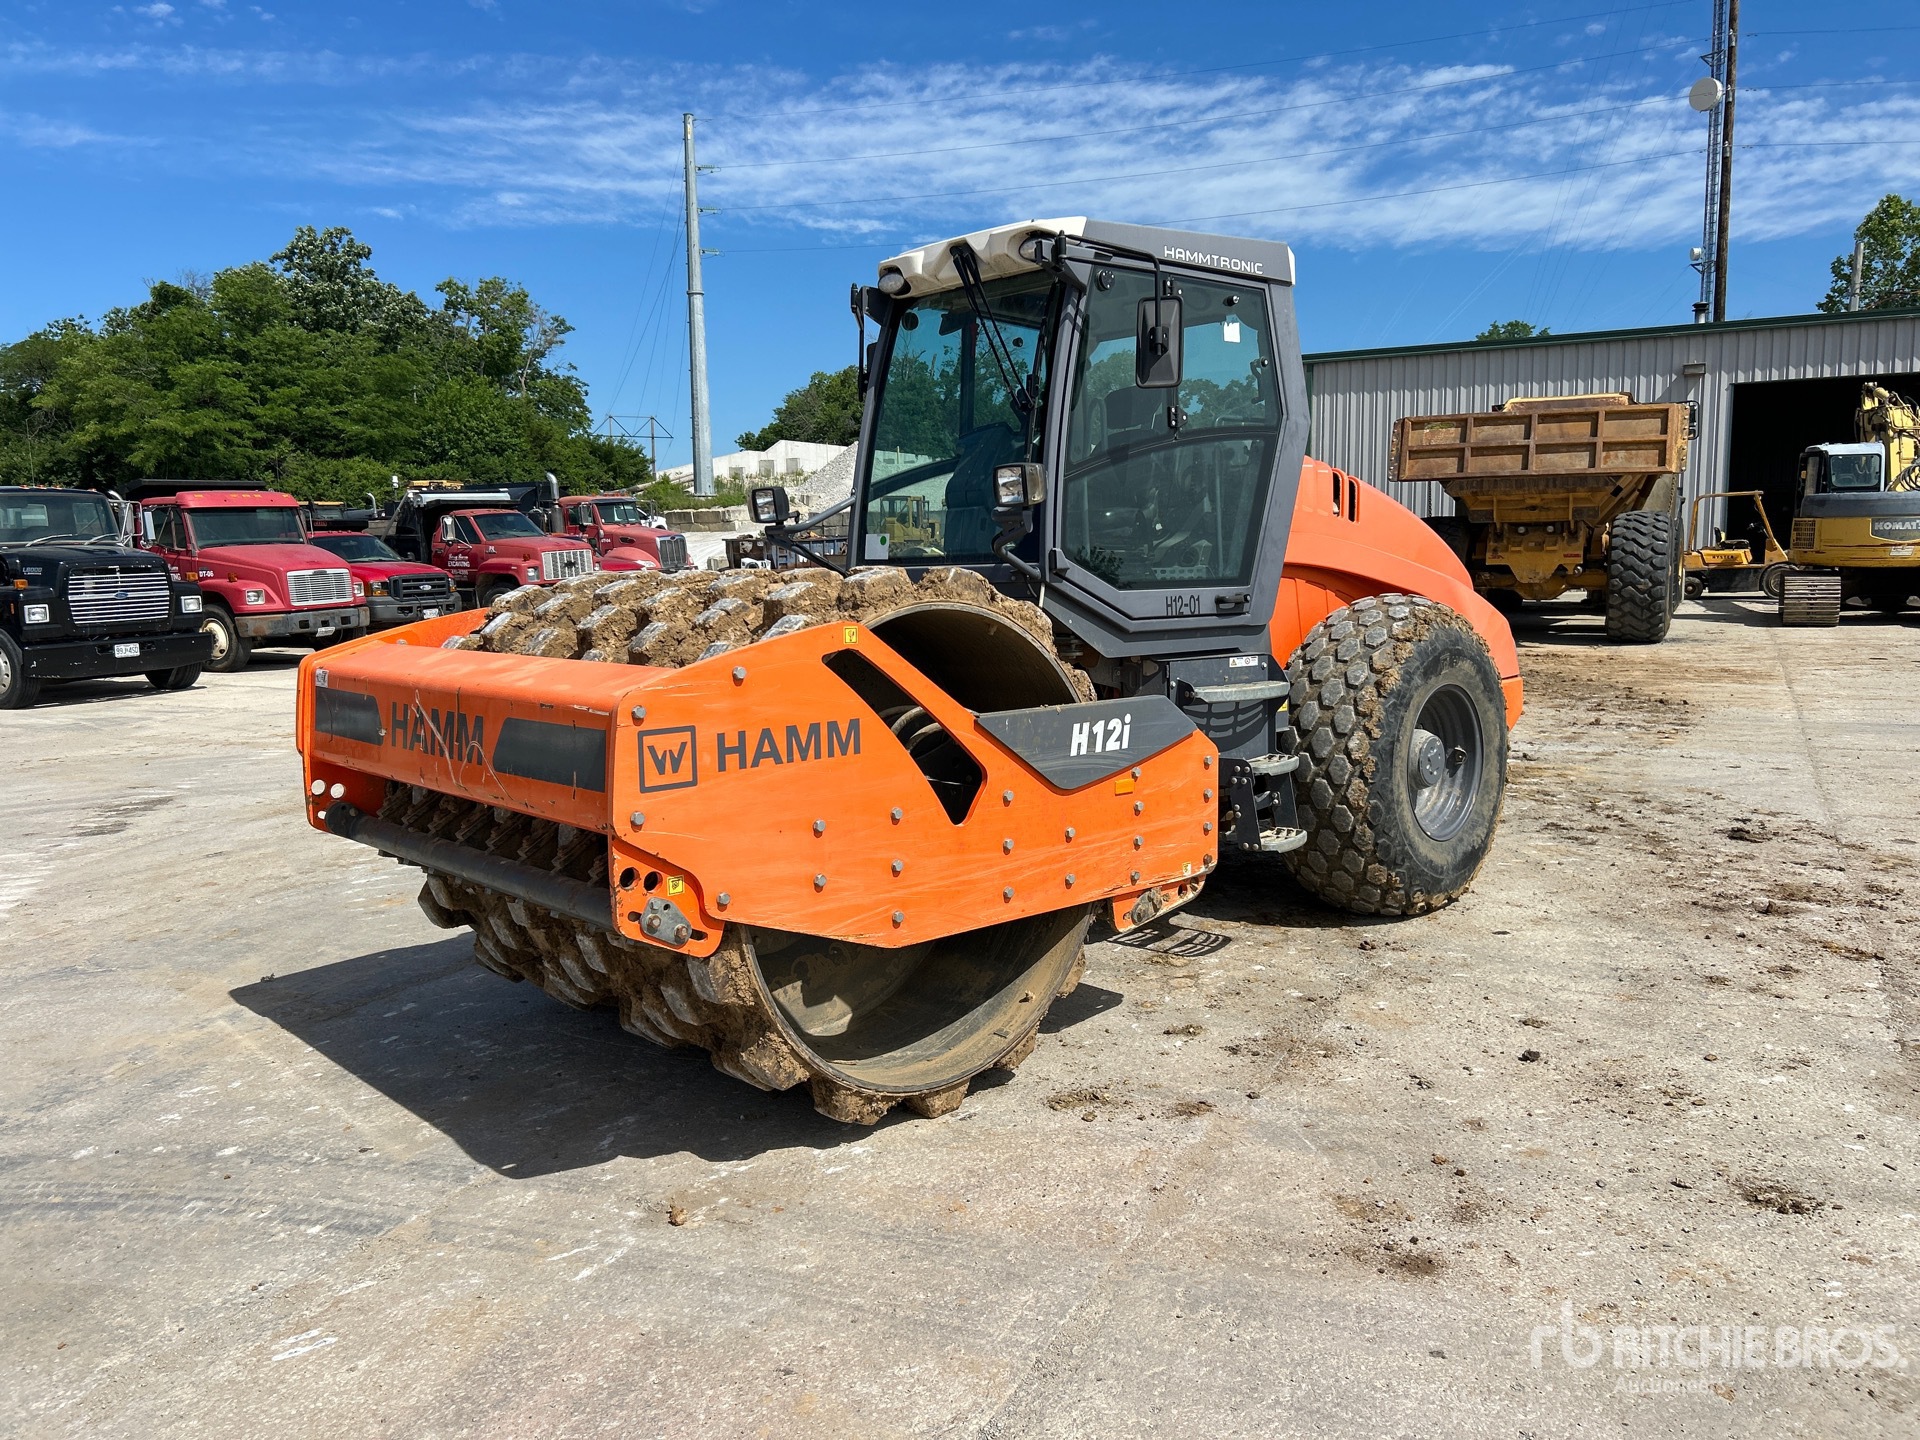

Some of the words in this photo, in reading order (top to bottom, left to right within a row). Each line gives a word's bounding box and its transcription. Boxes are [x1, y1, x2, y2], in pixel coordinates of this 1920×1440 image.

[1164, 245, 1263, 275] HAMMTRONIC
[1166, 595, 1200, 616] H12-01
[391, 701, 484, 766] HAMM
[716, 718, 861, 772] HAMM
[1070, 713, 1131, 757] H12i
